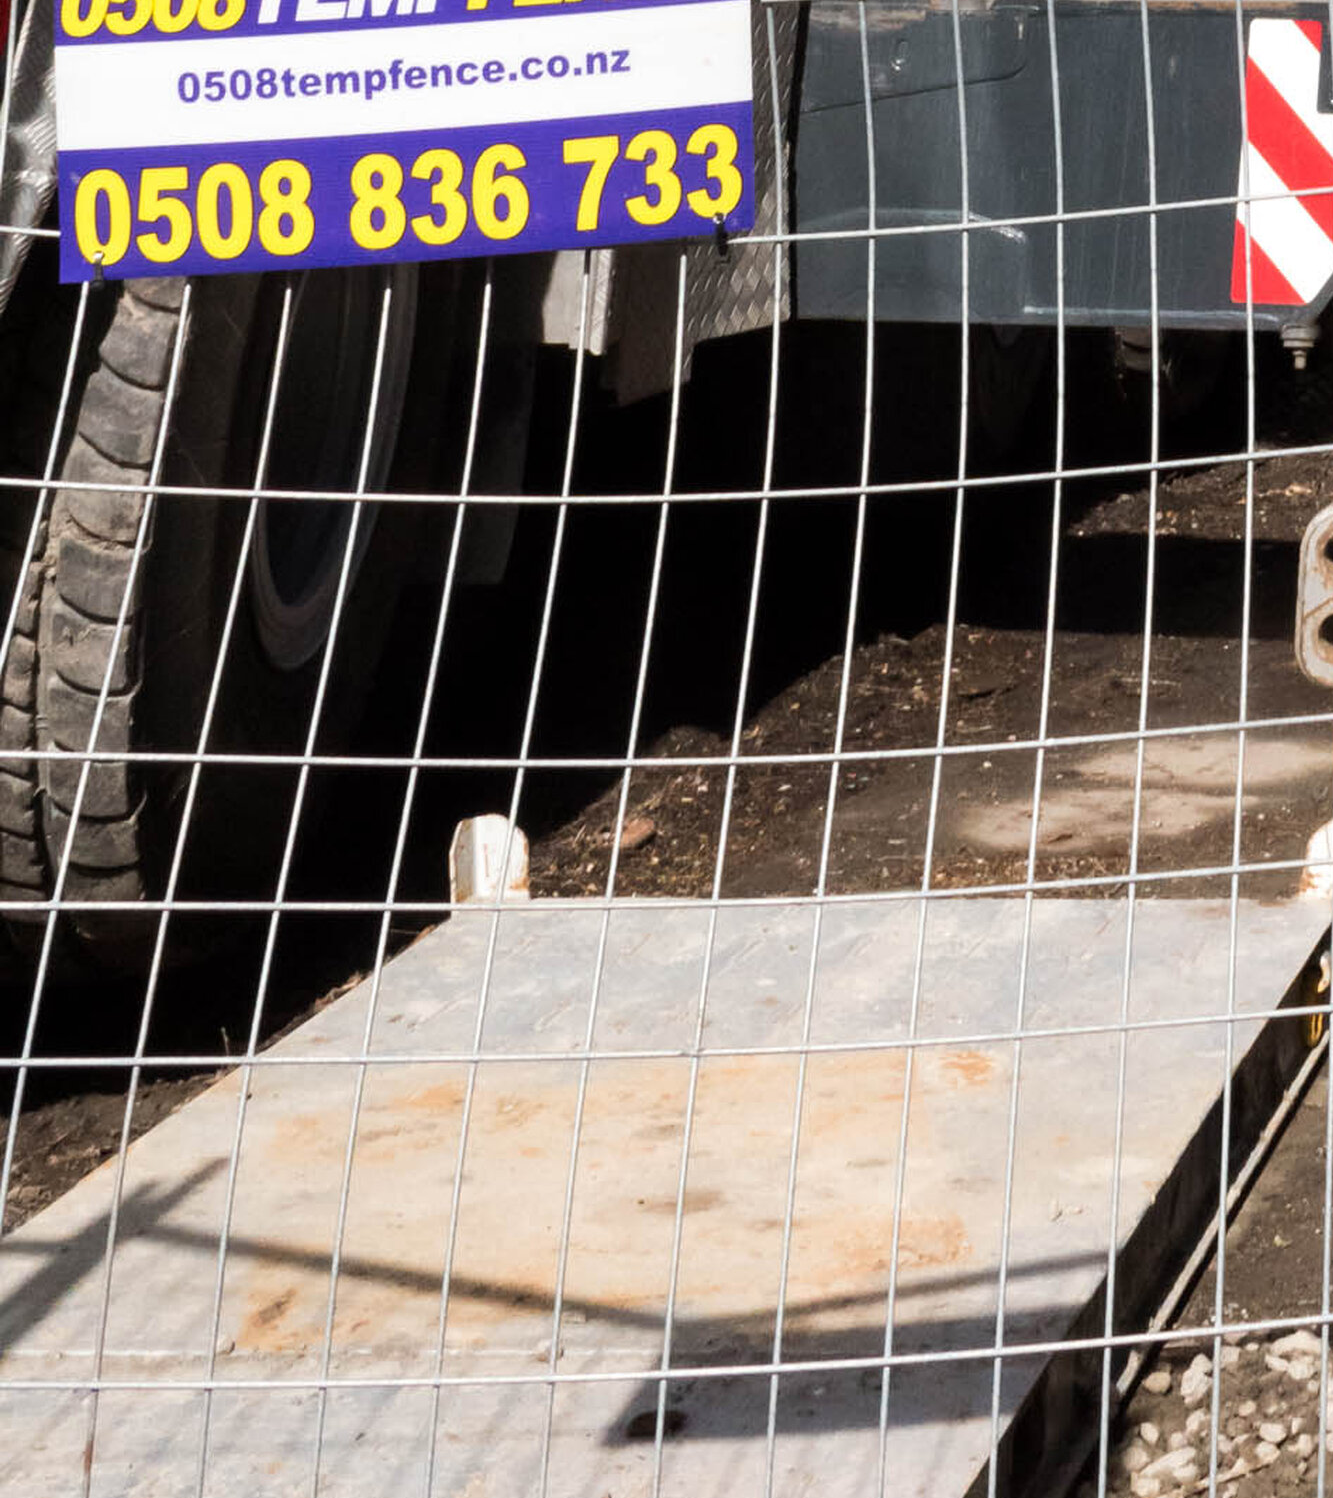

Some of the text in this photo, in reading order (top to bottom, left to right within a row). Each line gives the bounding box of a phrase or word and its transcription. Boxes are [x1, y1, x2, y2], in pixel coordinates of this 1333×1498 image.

[178, 46, 631, 105] 0508tempfence.co.nz
[74, 123, 744, 267] 0508 836 733
